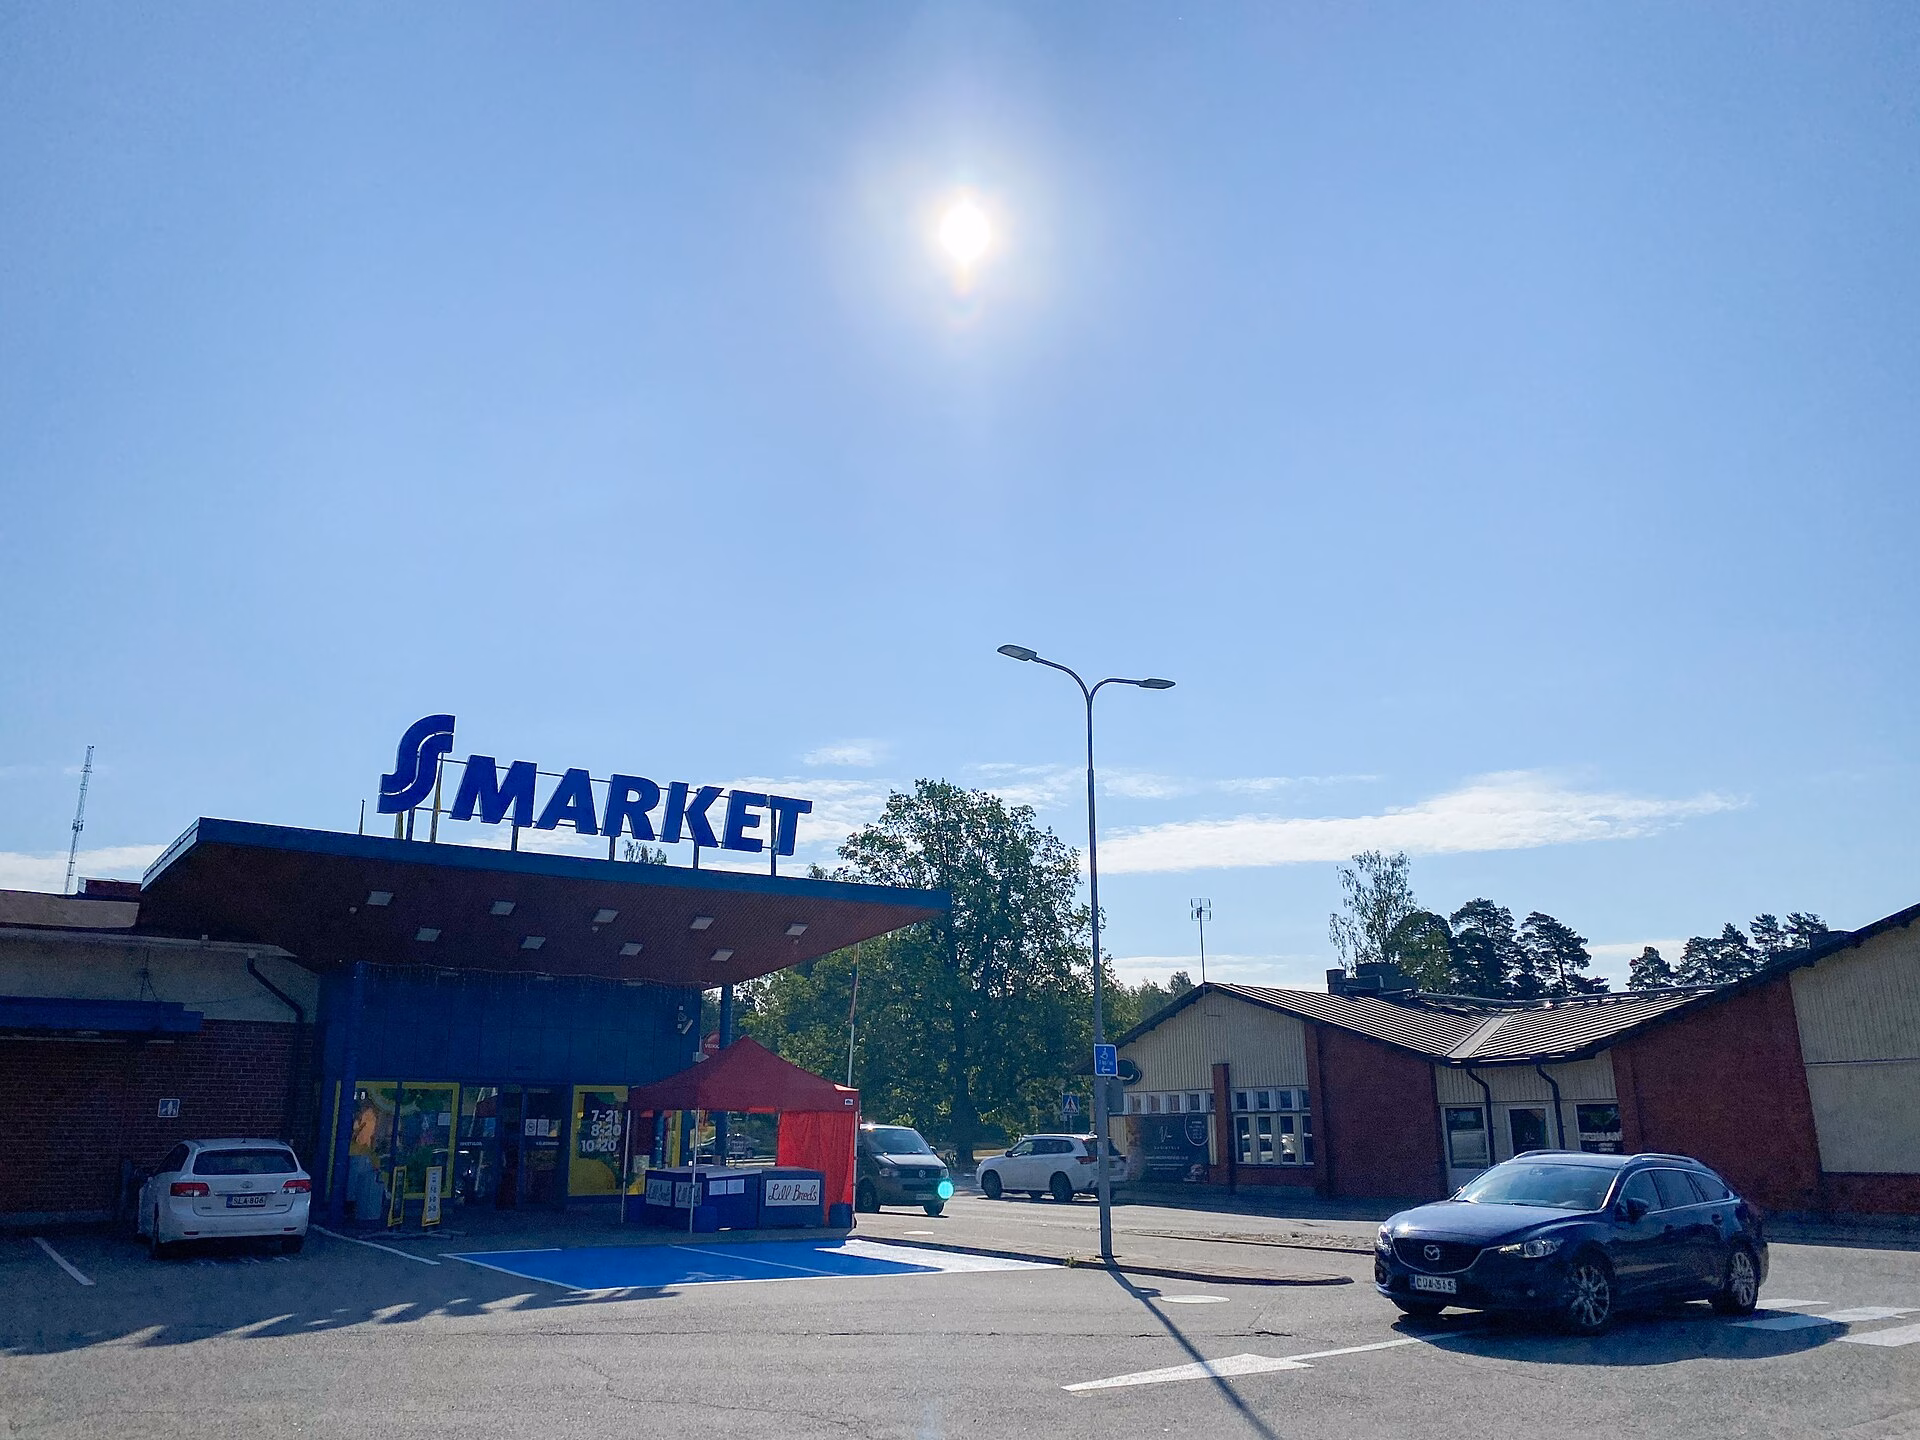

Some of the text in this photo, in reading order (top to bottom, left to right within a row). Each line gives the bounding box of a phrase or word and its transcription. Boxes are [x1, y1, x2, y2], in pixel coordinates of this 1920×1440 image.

[376, 713, 813, 856] S MARKET
[591, 1110, 620, 1124] 7-21
